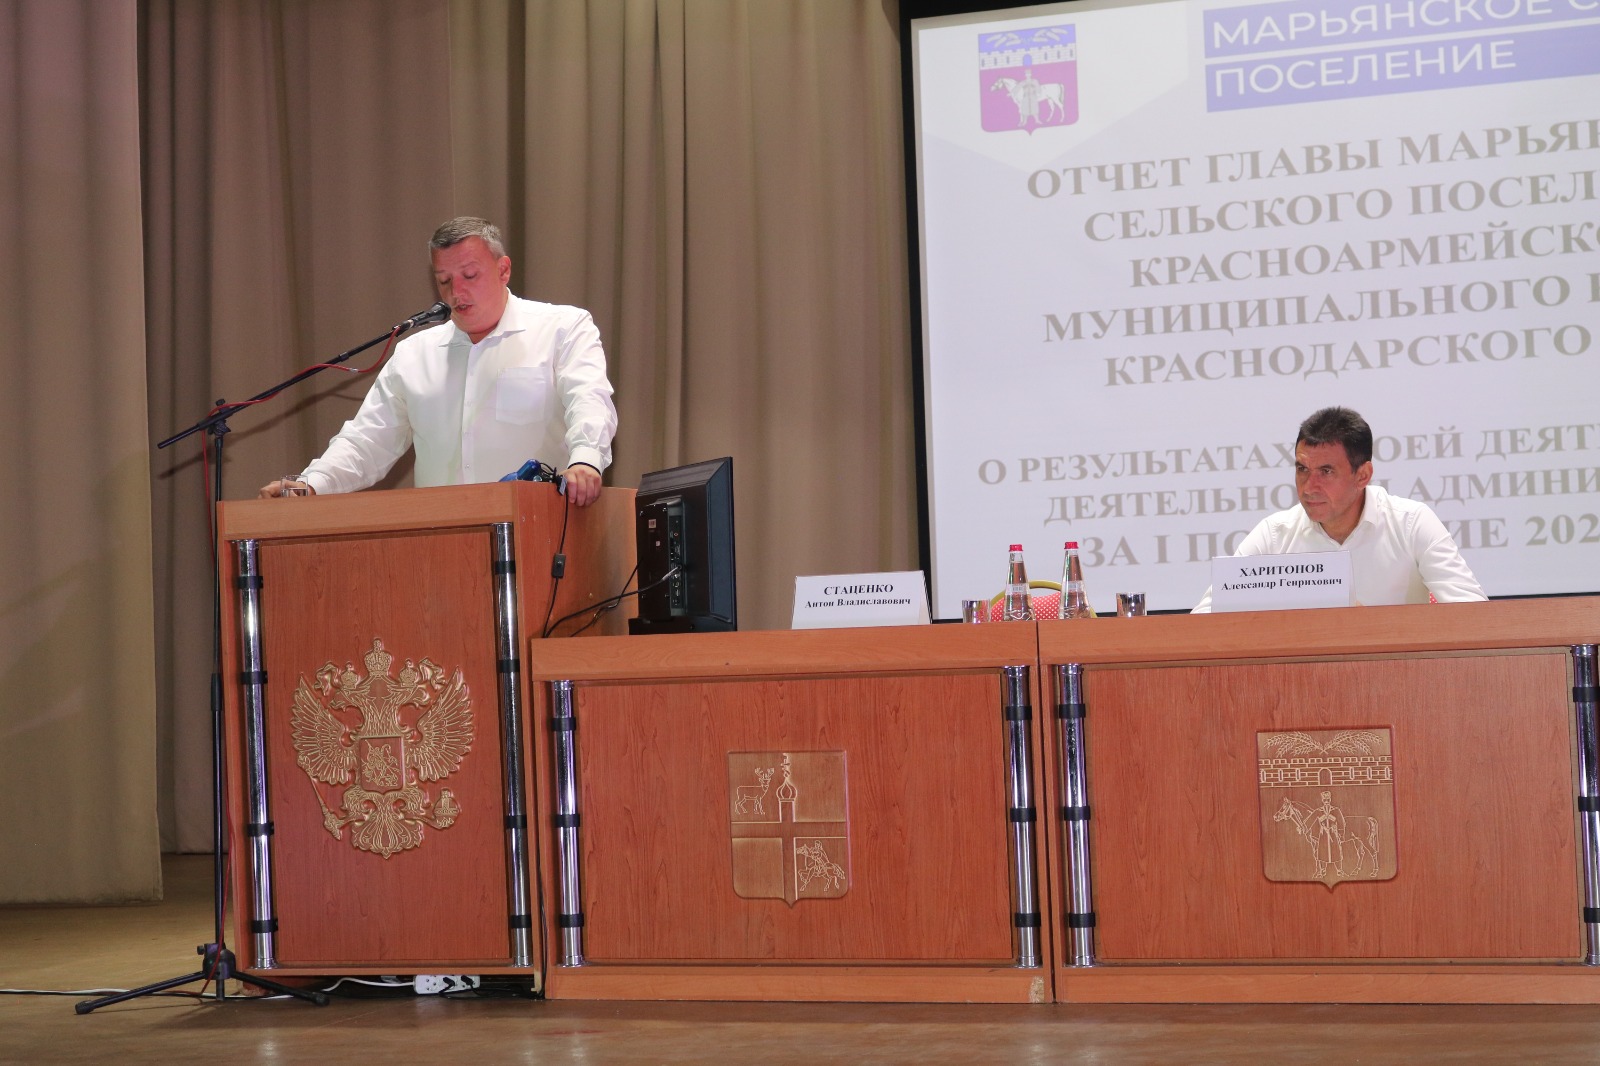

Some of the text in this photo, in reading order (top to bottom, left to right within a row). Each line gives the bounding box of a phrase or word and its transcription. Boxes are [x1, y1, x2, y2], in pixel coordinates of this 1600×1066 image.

[1213, 0, 1553, 48] МАРЬЯНСКОЕ
[1217, 40, 1516, 97] ПОСЕЛЕНИЕ
[1027, 157, 1191, 199] ОТЧЕТ
[1205, 140, 1382, 184] ГЛАВЫ
[1084, 169, 1600, 242] СЕЛЬСКОГО ПОСЕЛ
[1130, 221, 1600, 288] КРАСНОАРМЕЙСК
[1043, 275, 1571, 342] МУНИЦИПАЛЬНОГО
[1104, 324, 1592, 387] КРАСНОДАРСКОГО
[977, 424, 1600, 485] О РЕЗУЛЬТАТАХ ОЕЙ ДЕЯТ
[1082, 534, 1140, 568] ЗА
[1240, 563, 1324, 577] ХАРИТОНОВ
[805, 596, 911, 608] Антон Владиславович
[824, 584, 894, 596] СТАЦЕНКО
[1222, 577, 1343, 591] Александр Генрихович
